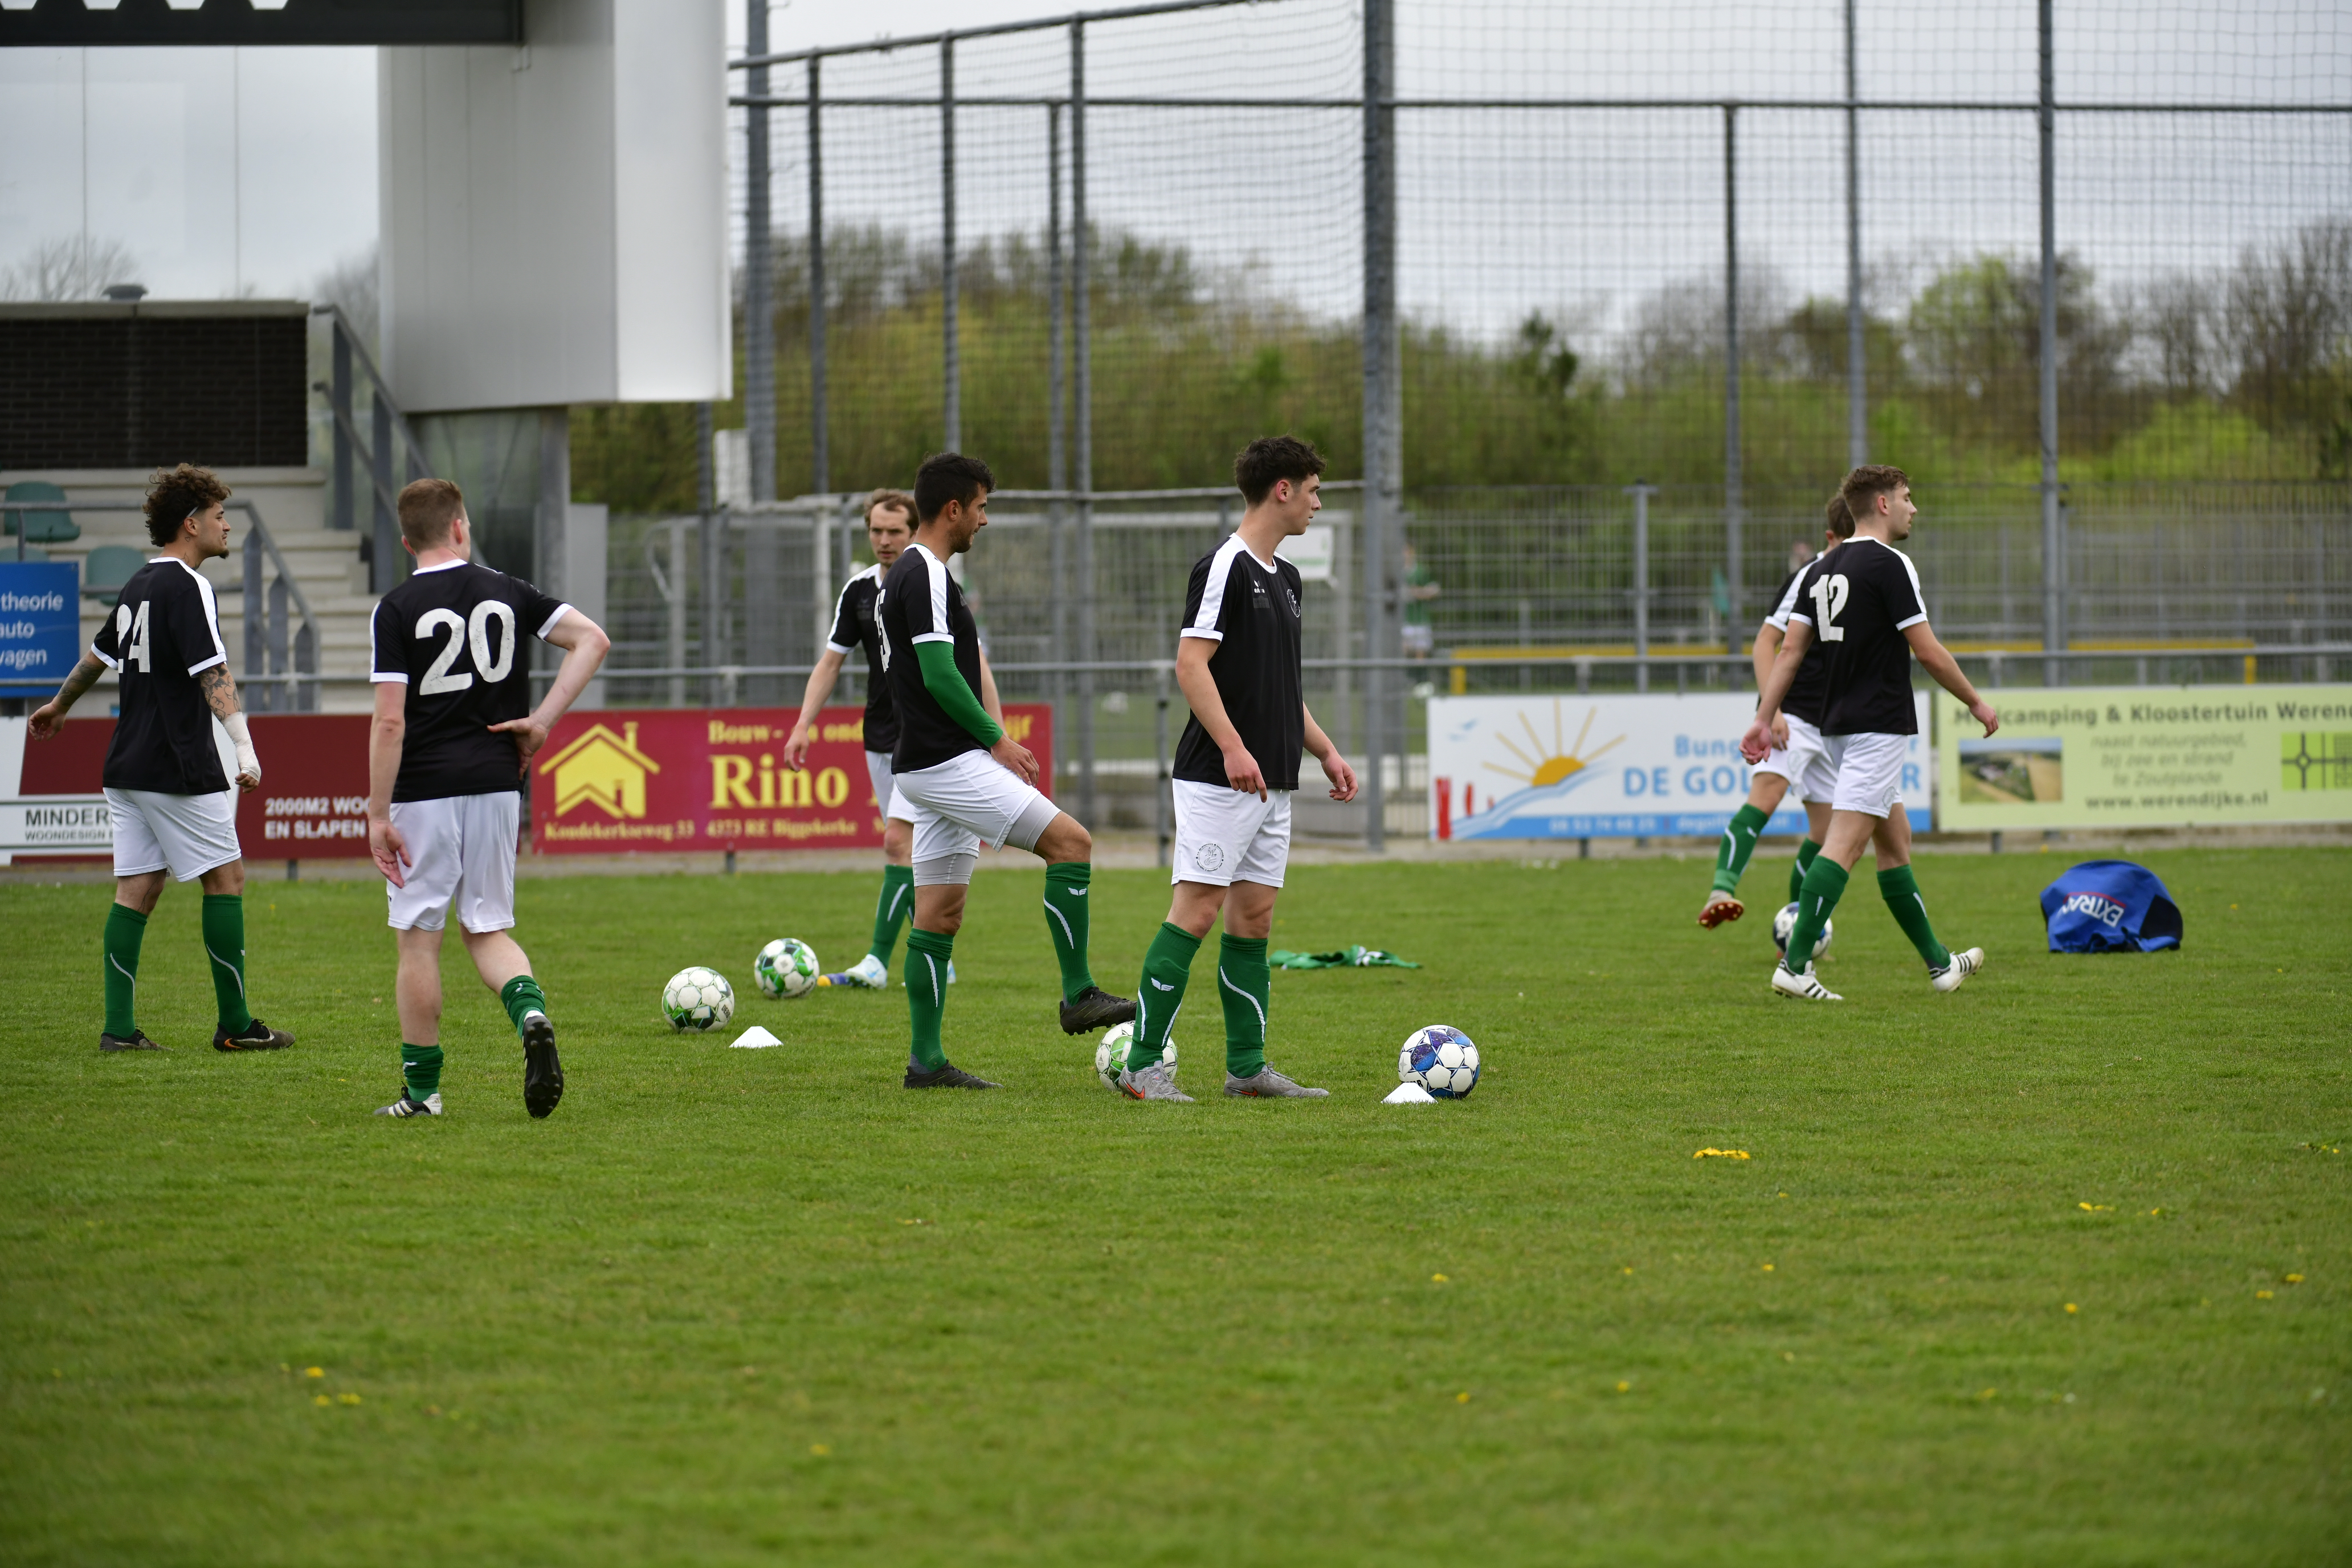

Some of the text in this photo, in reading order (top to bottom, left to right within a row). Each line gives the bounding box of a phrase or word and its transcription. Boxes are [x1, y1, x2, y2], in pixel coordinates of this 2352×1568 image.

[1, 590, 64, 612] theorie
[1809, 574, 1849, 642] 12
[116, 601, 150, 673] 24
[415, 599, 515, 696] 20
[0, 649, 47, 671] agen
[2106, 705, 2121, 723] &
[2130, 702, 2268, 722] Kloostertuin
[2276, 700, 2352, 721] Weren
[709, 753, 849, 808] Rino
[1624, 767, 1670, 797] DE
[25, 808, 113, 827] MINDER
[264, 797, 330, 816] 2000M2
[25, 830, 105, 842] WOONDESIGN
[264, 819, 366, 839] EN SLAPEN
